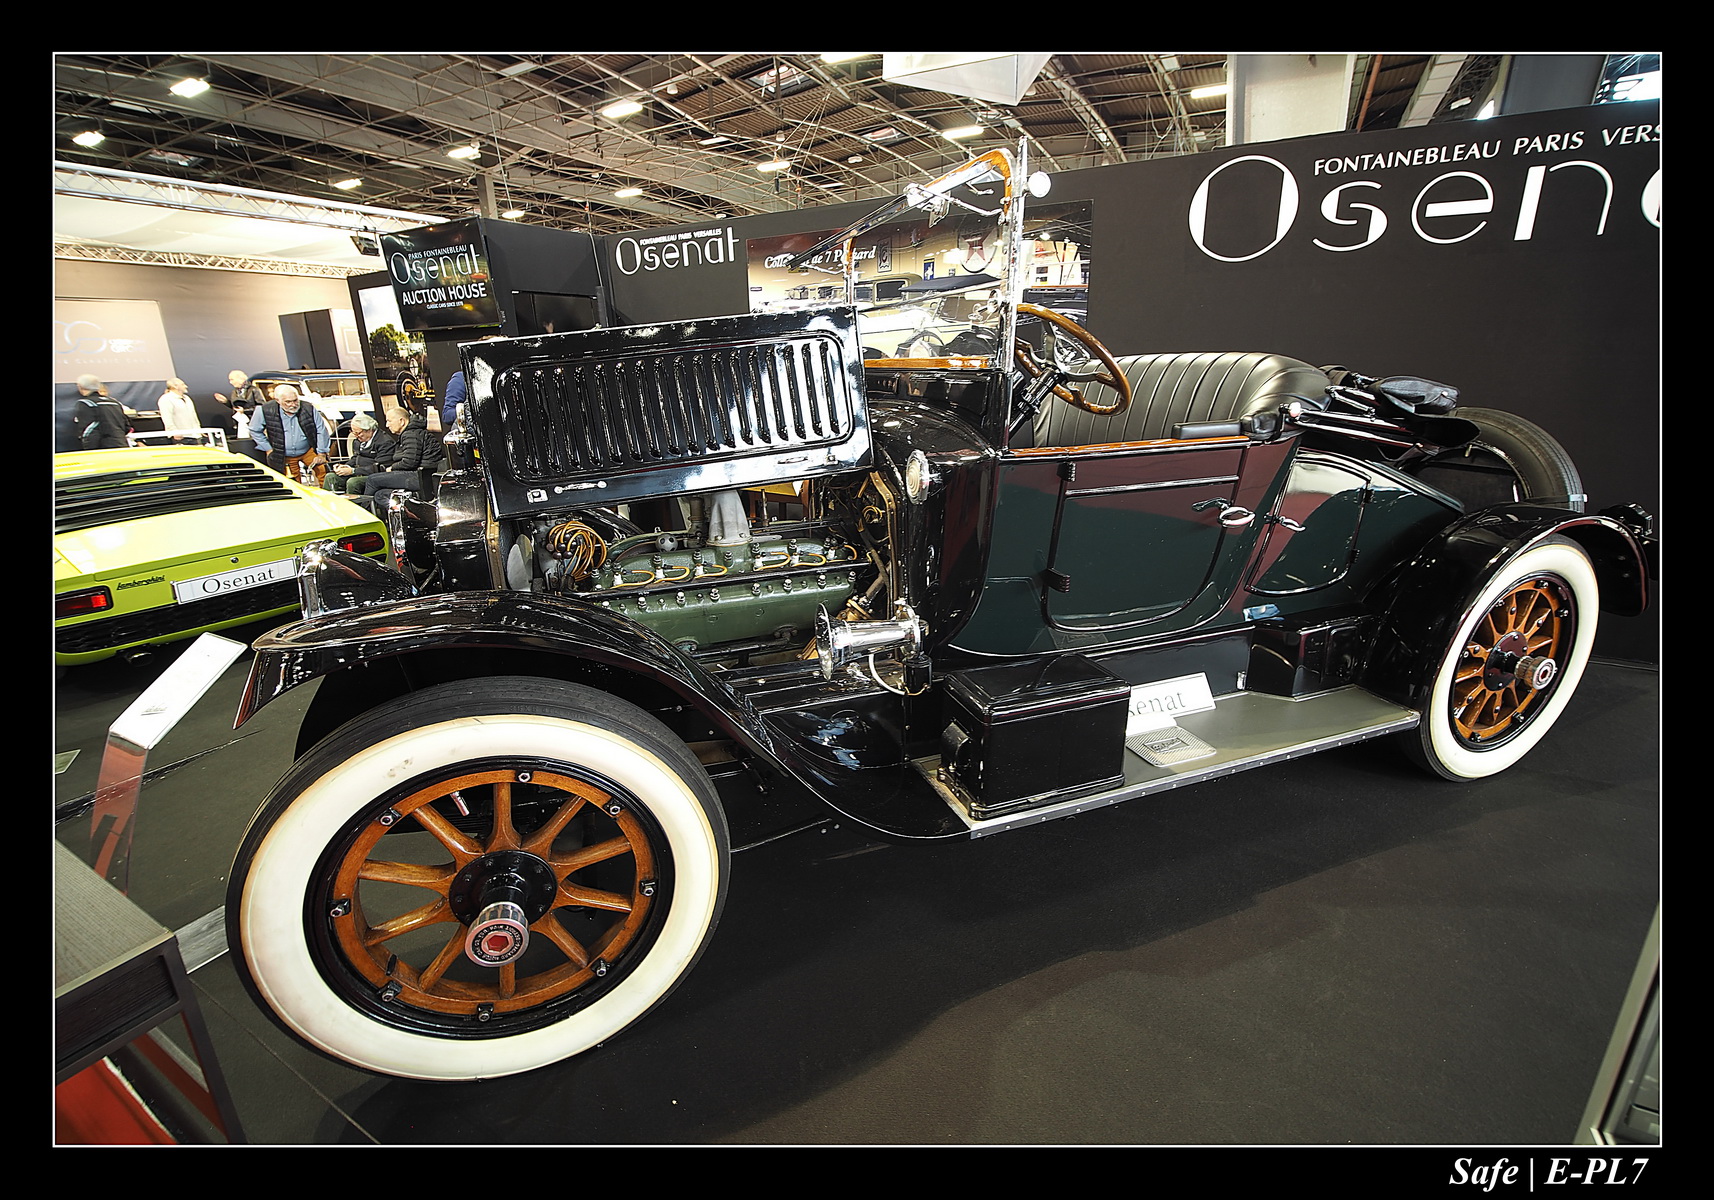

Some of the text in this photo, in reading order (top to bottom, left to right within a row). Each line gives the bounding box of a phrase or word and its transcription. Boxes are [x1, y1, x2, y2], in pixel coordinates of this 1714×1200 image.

[1313, 140, 1501, 176] FONTAINEBLEAU
[1513, 131, 1585, 156] PARIS
[1188, 154, 1660, 263] Osen
[678, 232, 692, 240] PARIS
[390, 243, 480, 285] Osenat
[408, 244, 468, 260] PARIS FONTAINEBLEAU
[615, 226, 740, 275] Osenat
[825, 250, 833, 263] 7
[402, 282, 488, 305] AUCTION HOUSE
[202, 567, 275, 594] Osenat
